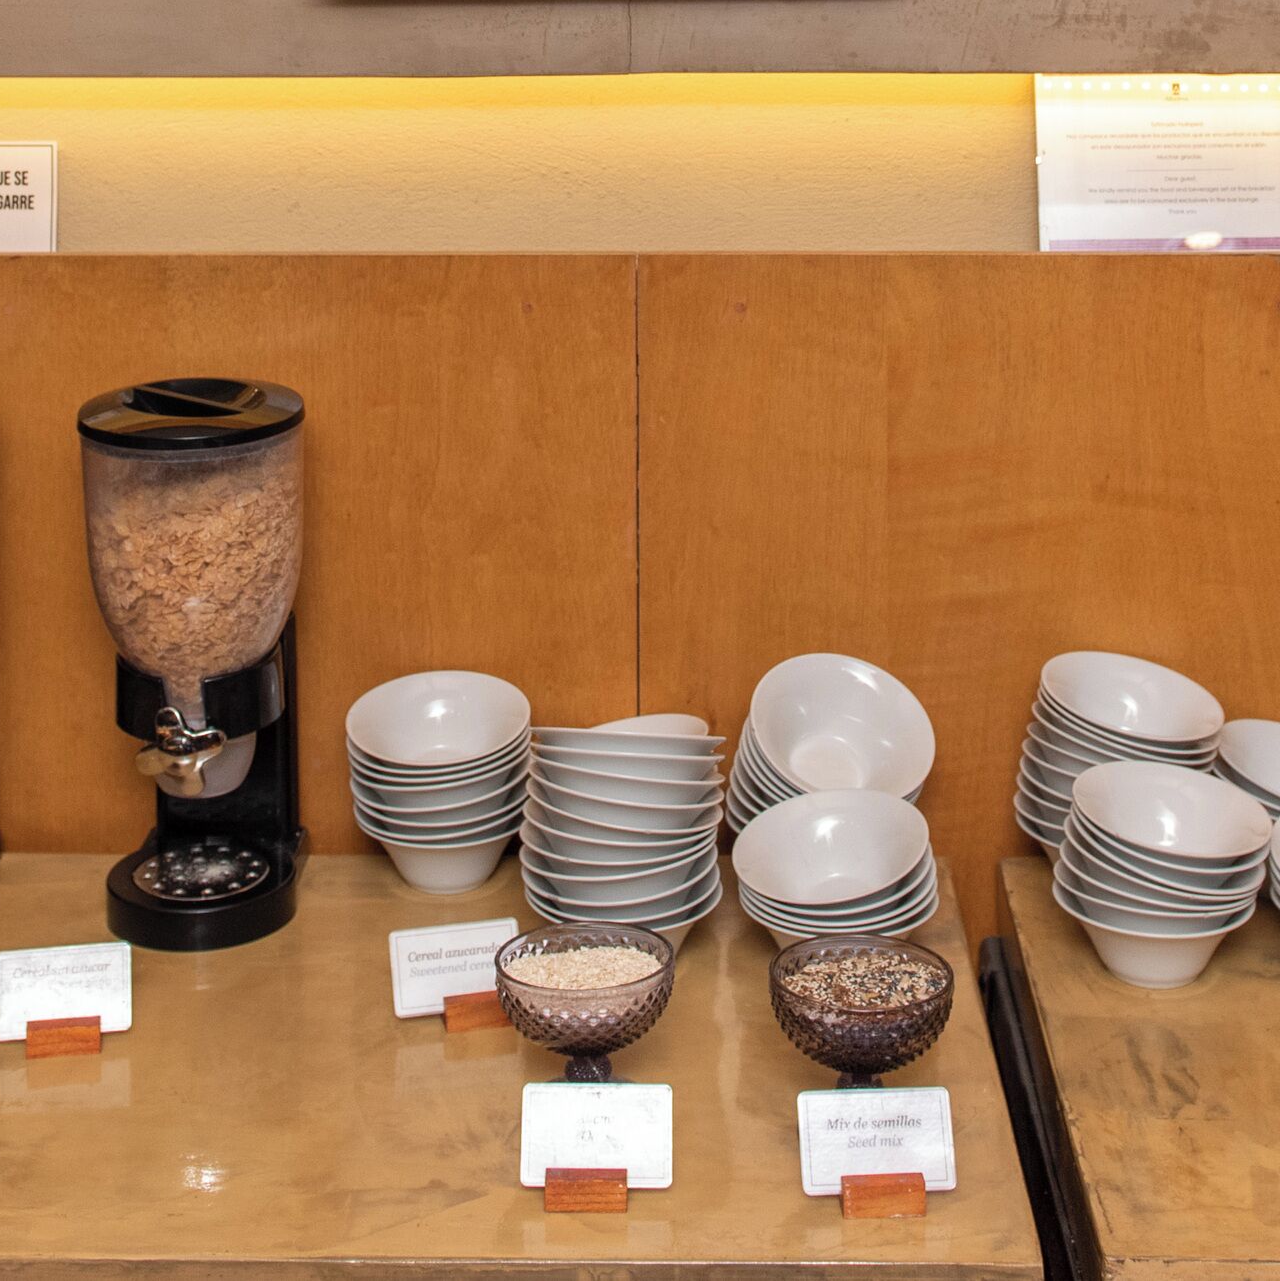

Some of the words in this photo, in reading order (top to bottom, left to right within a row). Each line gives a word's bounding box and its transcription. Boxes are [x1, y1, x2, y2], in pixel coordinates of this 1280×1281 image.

[14, 170, 29, 186] SE
[408, 948, 442, 963] Cereal
[410, 962, 467, 978] Sweetened
[827, 1118, 850, 1130] Mix
[853, 1117, 868, 1130] de
[871, 1115, 922, 1129] semillas
[848, 1135, 876, 1149] Seed
[880, 1135, 904, 1148] mix
